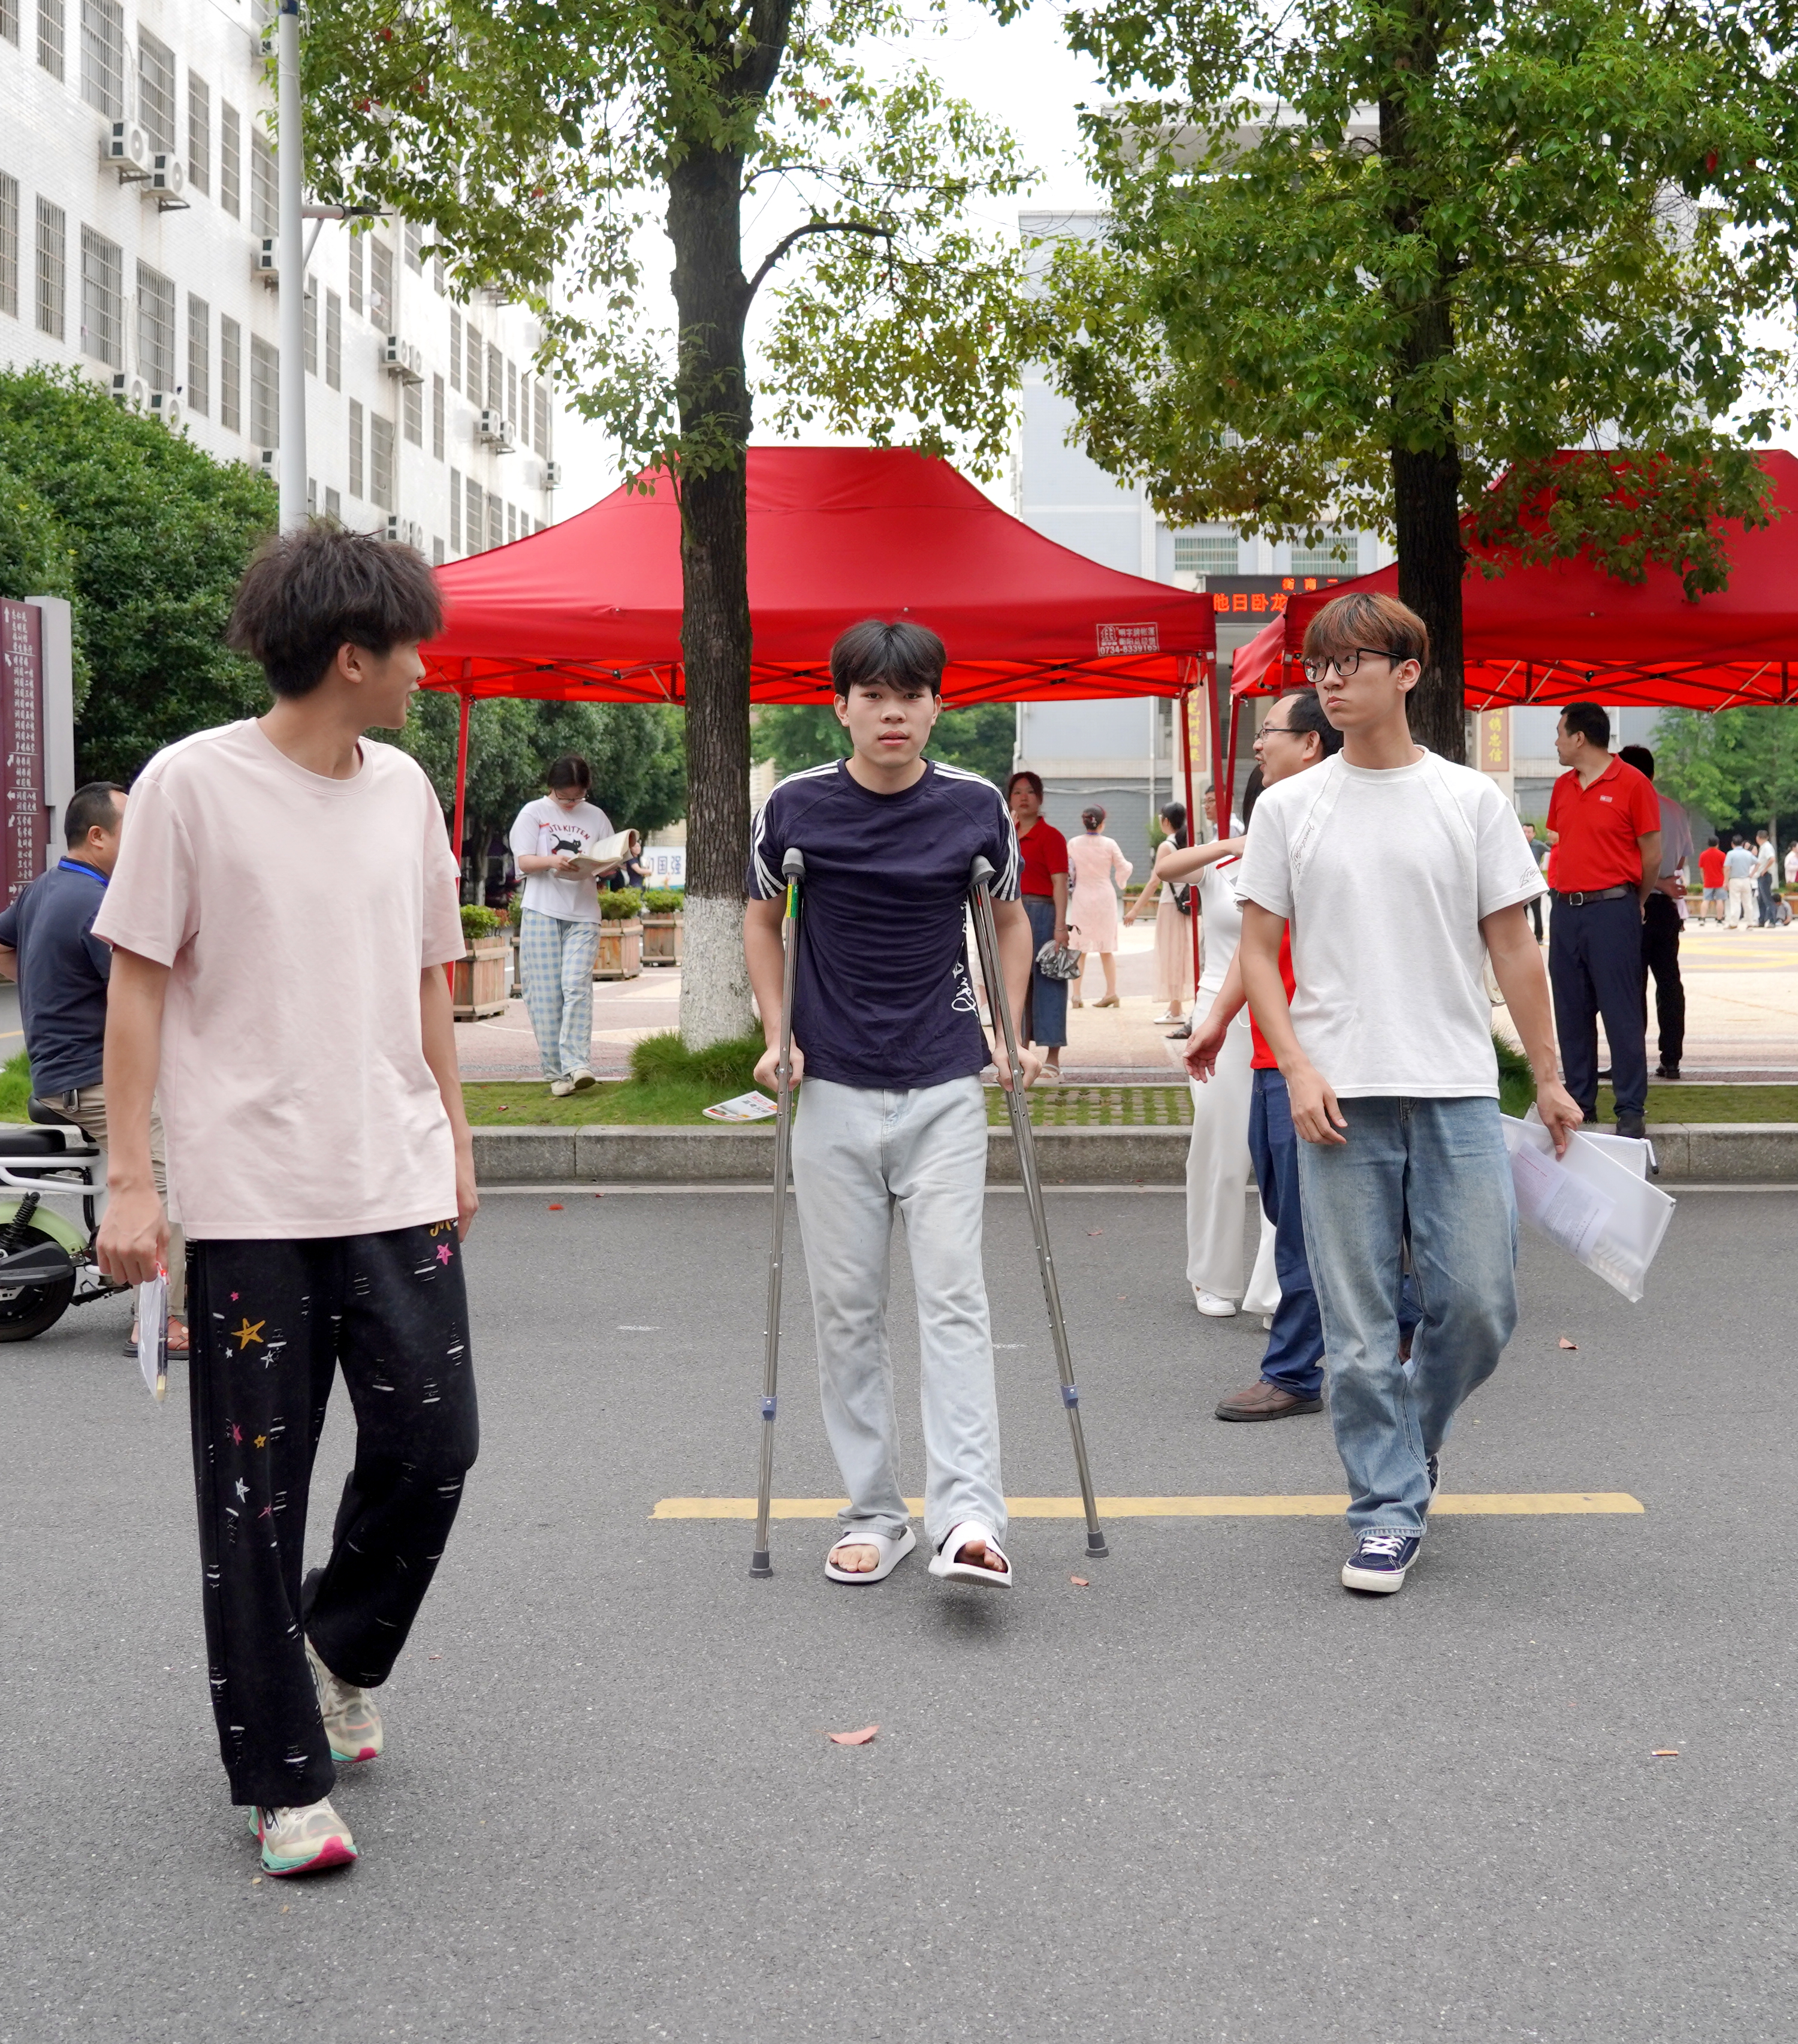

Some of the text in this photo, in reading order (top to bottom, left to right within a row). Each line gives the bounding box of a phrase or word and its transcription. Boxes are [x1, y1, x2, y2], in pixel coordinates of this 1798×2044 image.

[1213, 592, 1303, 613] 他日卧龙
[548, 824, 591, 840] UTE KITTEN
